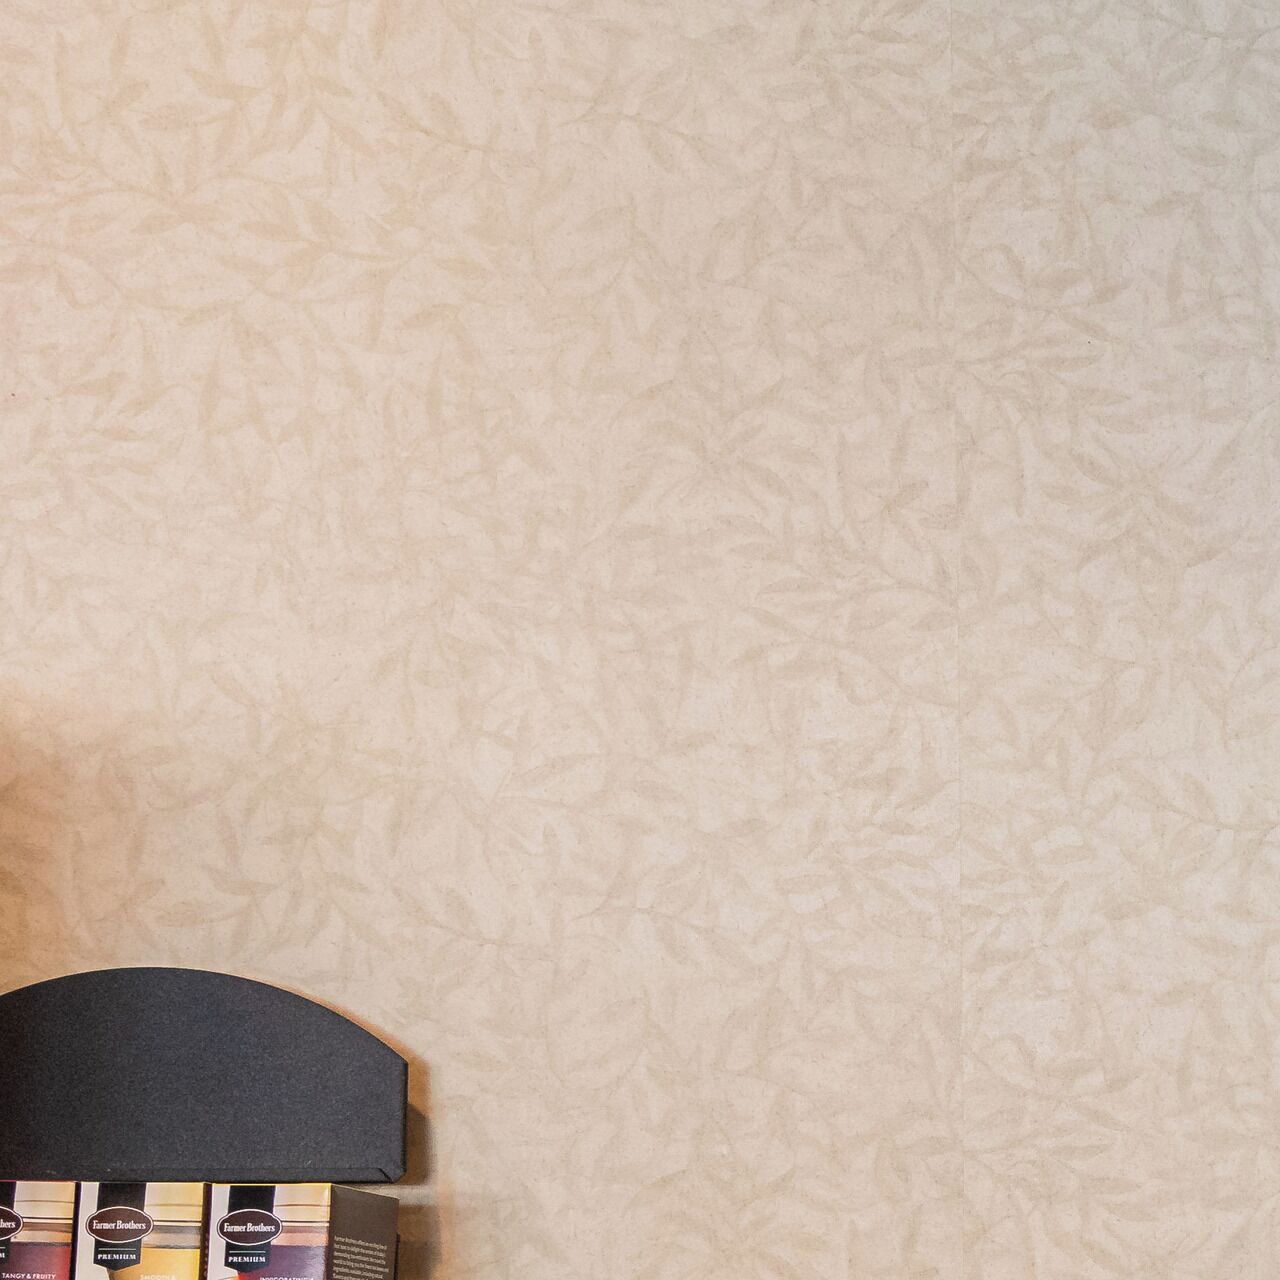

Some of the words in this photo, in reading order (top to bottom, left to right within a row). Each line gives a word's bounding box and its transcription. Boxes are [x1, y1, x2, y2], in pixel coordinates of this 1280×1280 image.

[93, 1221, 116, 1230] Farmer
[116, 1221, 147, 1231] Brothers
[223, 1222, 247, 1232] Farmer
[247, 1222, 276, 1233] Brothers
[228, 1255, 266, 1263] PREMIUM
[2, 1272, 25, 1280] TANGY
[33, 1273, 57, 1280] FRUITY
